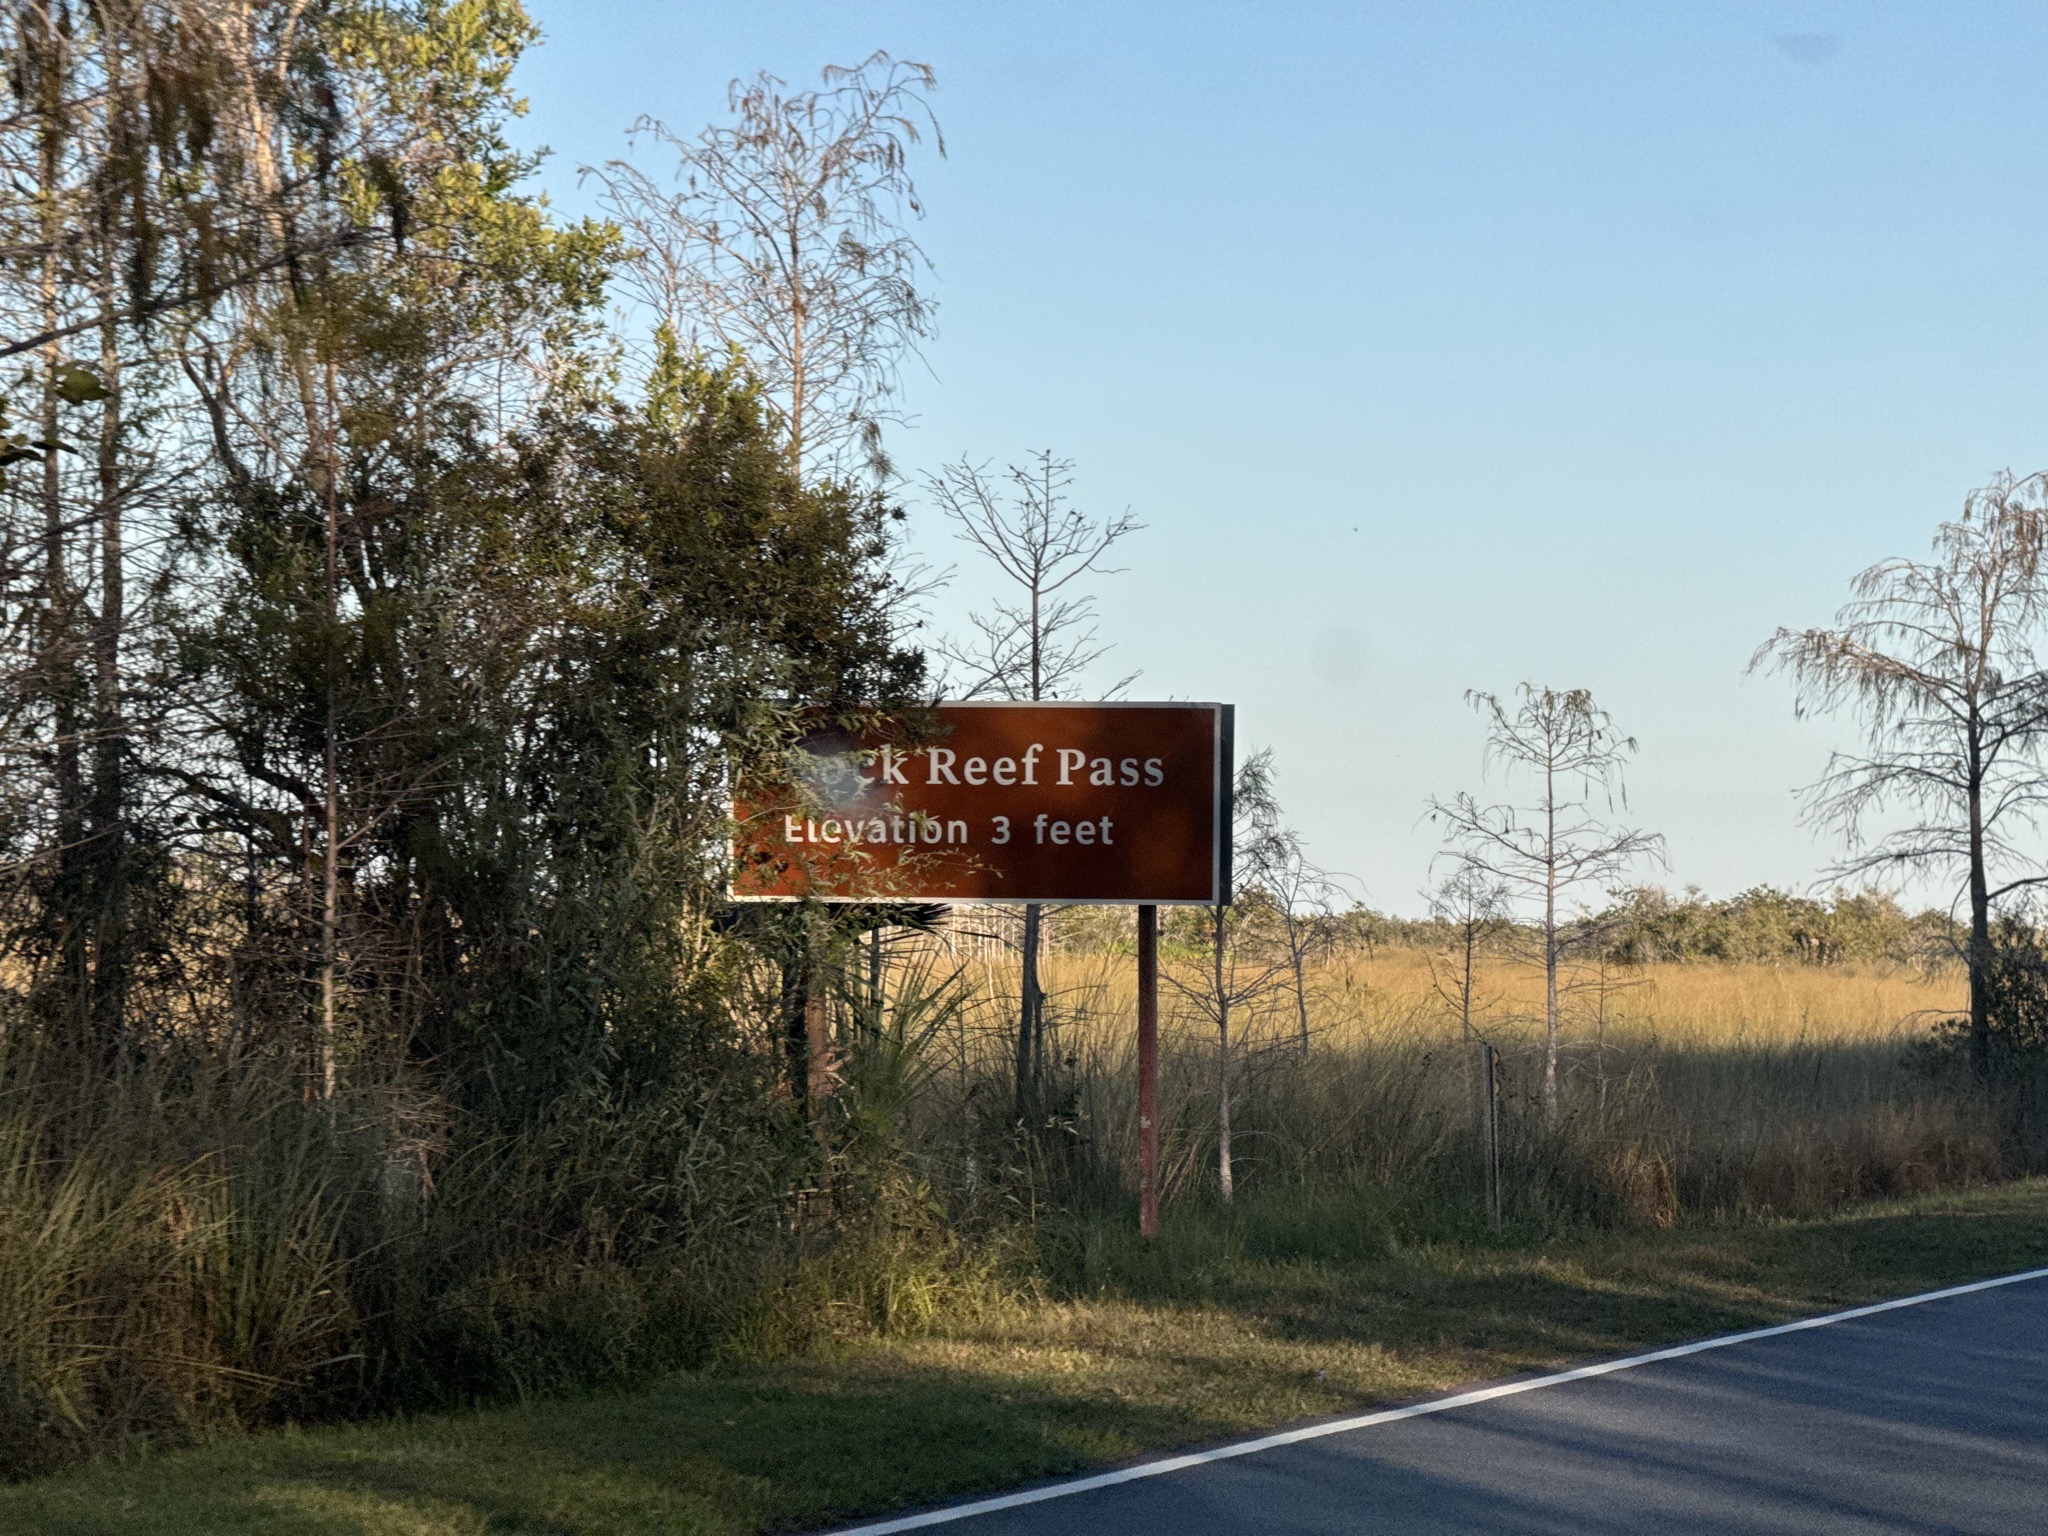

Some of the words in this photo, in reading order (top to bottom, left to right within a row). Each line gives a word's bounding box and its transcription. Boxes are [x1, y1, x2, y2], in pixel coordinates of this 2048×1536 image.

[926, 743, 1044, 786] Reef
[1056, 748, 1164, 787] Pass
[990, 815, 1011, 845] 3
[1033, 813, 1114, 845] feet
